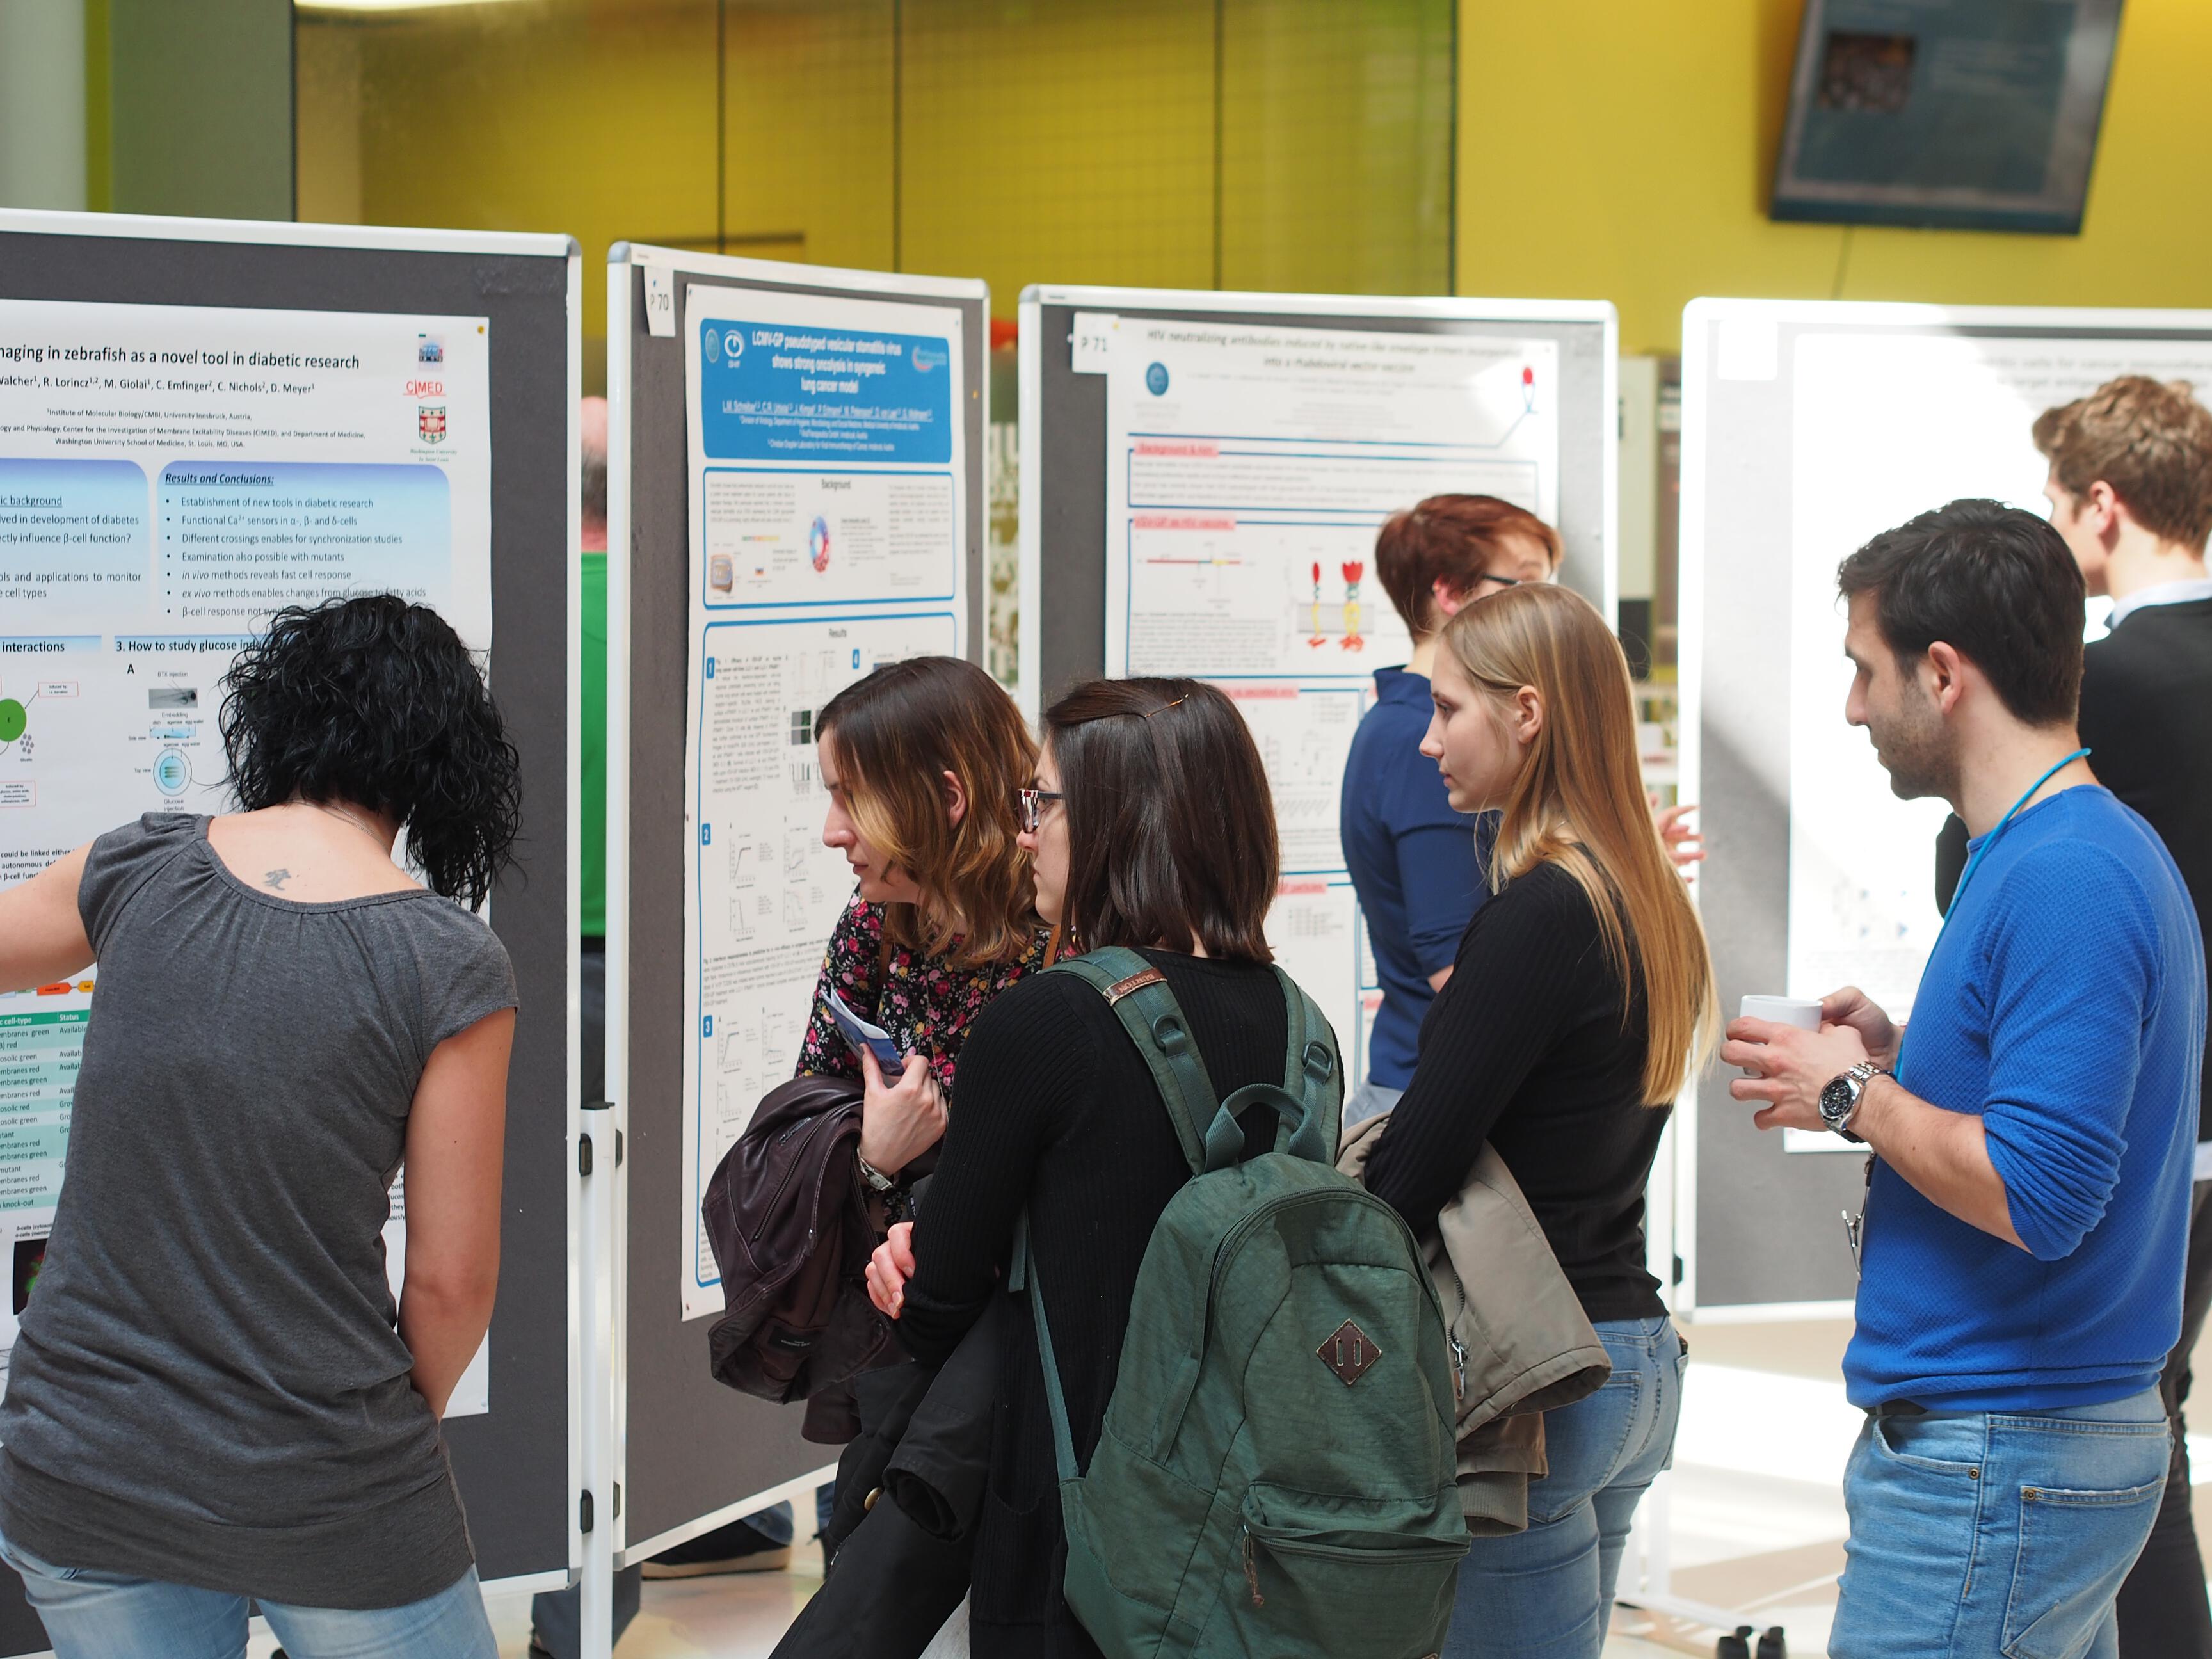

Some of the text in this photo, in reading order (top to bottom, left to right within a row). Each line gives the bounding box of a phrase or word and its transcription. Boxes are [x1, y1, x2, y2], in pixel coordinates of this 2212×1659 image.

[657, 293, 669, 311] 70
[1169, 330, 1226, 346] neutralizing
[886, 341, 902, 357] virus
[1081, 337, 1107, 353] P 71
[48, 344, 60, 360] in
[65, 346, 126, 362] zebrafish
[131, 351, 145, 363] as
[149, 351, 156, 363] a
[162, 349, 198, 364] novel
[202, 350, 228, 365] tool
[233, 351, 244, 365] in
[249, 351, 301, 367] diabetic
[305, 355, 359, 369] research
[772, 354, 793, 369] shows
[794, 355, 815, 374] strong
[847, 358, 853, 373] in
[44, 376, 52, 387] R.
[104, 378, 116, 389] M.
[156, 380, 164, 390] C.
[218, 381, 225, 391] C.
[271, 383, 280, 392] D.
[406, 379, 443, 394] CIMED
[801, 376, 859, 396] lung cancer model
[164, 412, 195, 420] University
[13, 424, 25, 433] and
[108, 425, 147, 435] Investigation
[192, 428, 224, 437] Excitability
[293, 430, 328, 438] Department
[55, 437, 92, 447] Washington
[94, 438, 125, 447] University
[127, 438, 147, 447] School
[165, 473, 274, 485] Results and Conclusions:
[821, 478, 851, 492] Background
[10, 495, 62, 507] background
[182, 497, 239, 507] Establishment
[243, 497, 250, 507] of
[273, 497, 293, 508] tools
[295, 498, 302, 507] in
[305, 498, 337, 508] diabetic
[340, 498, 373, 508] research
[20, 514, 28, 524] in
[31, 513, 88, 527] development
[91, 514, 100, 525] of
[102, 514, 139, 525] diabetes
[182, 515, 225, 525] Functional
[248, 517, 278, 525] sensors
[281, 516, 287, 525] in
[315, 515, 330, 525] and
[20, 533, 61, 543] influence
[90, 533, 131, 543] function?
[182, 533, 402, 545] Different crossings enables for synchronization studies
[182, 551, 344, 563] Examination also possible with mutants
[15, 571, 31, 582] and
[36, 572, 88, 584] applications
[93, 572, 102, 582] to
[107, 572, 141, 582] monitor
[182, 569, 351, 581] in vivo methods reveals fast cell response
[5, 587, 47, 600] cell types
[195, 589, 211, 598] vivo
[213, 588, 250, 598] methods
[252, 588, 284, 598] enables
[286, 588, 319, 600] changes
[321, 587, 341, 597] from
[406, 587, 426, 597] acids
[208, 608, 245, 618] response
[829, 627, 847, 639] Results
[2, 641, 65, 652] interactions
[116, 641, 125, 652] 3.
[129, 641, 152, 651] How
[156, 641, 165, 651] to
[168, 639, 196, 653] study
[199, 640, 237, 652] glucose
[127, 664, 134, 675] A
[703, 828, 709, 840] 2
[1, 850, 18, 858] could
[20, 849, 28, 858] be
[30, 849, 50, 857] linked
[2, 862, 42, 870] autonomous
[1118, 974, 1155, 993] BURTON
[705, 1020, 710, 1032] 3
[3, 1199, 34, 1208] knock-out
